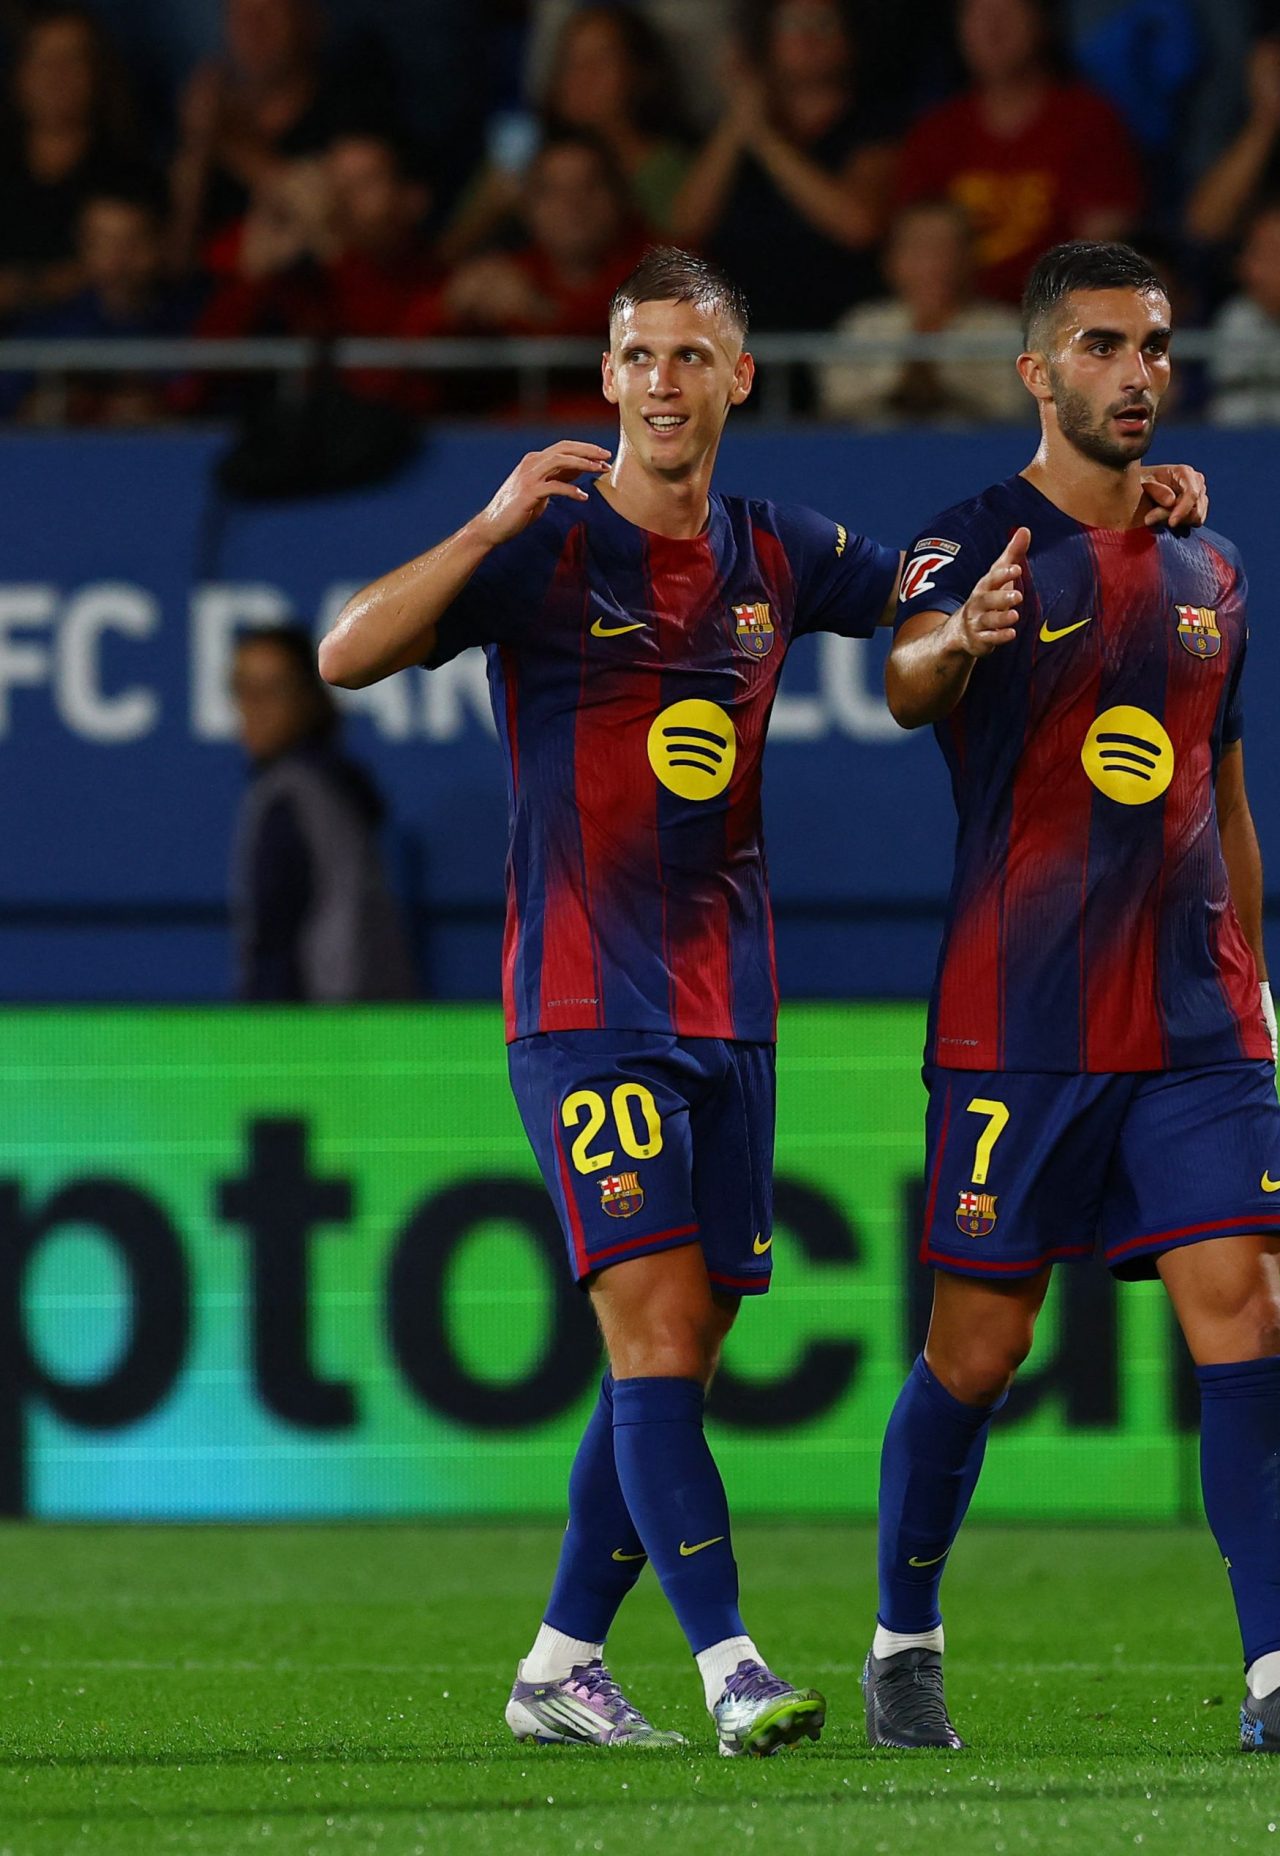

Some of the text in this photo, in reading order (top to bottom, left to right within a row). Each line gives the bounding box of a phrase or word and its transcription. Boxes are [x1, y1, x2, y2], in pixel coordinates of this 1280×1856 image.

[0, 582, 158, 743] FC
[561, 1082, 664, 1175] 20
[966, 1098, 1010, 1184] 7
